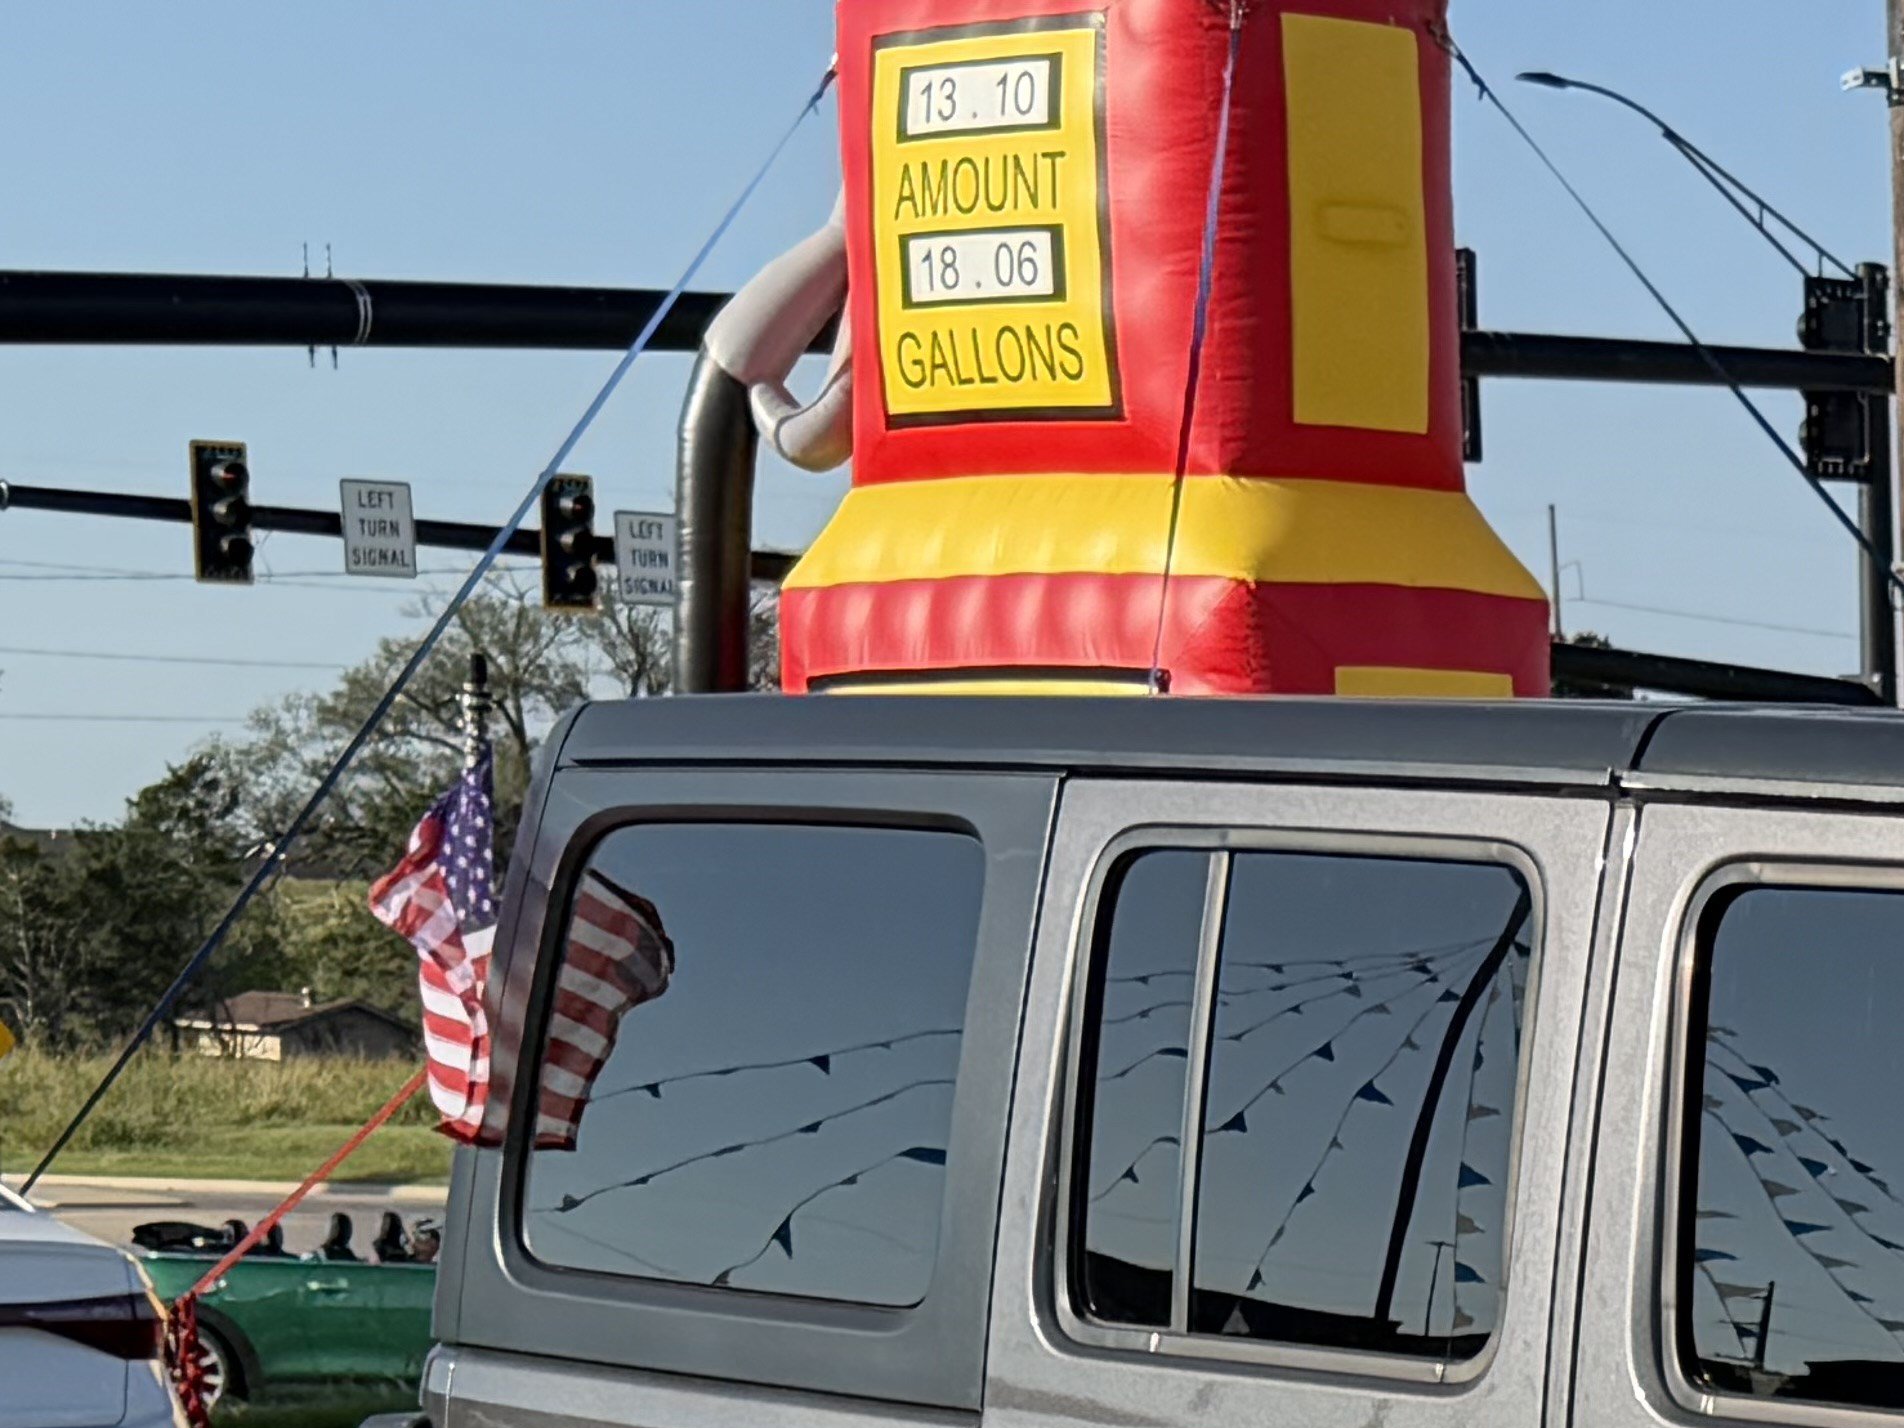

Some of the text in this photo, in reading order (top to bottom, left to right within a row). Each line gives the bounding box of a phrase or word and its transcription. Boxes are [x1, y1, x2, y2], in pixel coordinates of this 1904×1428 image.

[894, 150, 1067, 221] AMOUNT
[896, 321, 1084, 389] GALLONS
[356, 488, 395, 511] LEFT
[358, 517, 401, 539] TURN
[628, 519, 664, 542] LEFT
[351, 548, 411, 570] SIGNAL
[630, 547, 670, 569] TURN
